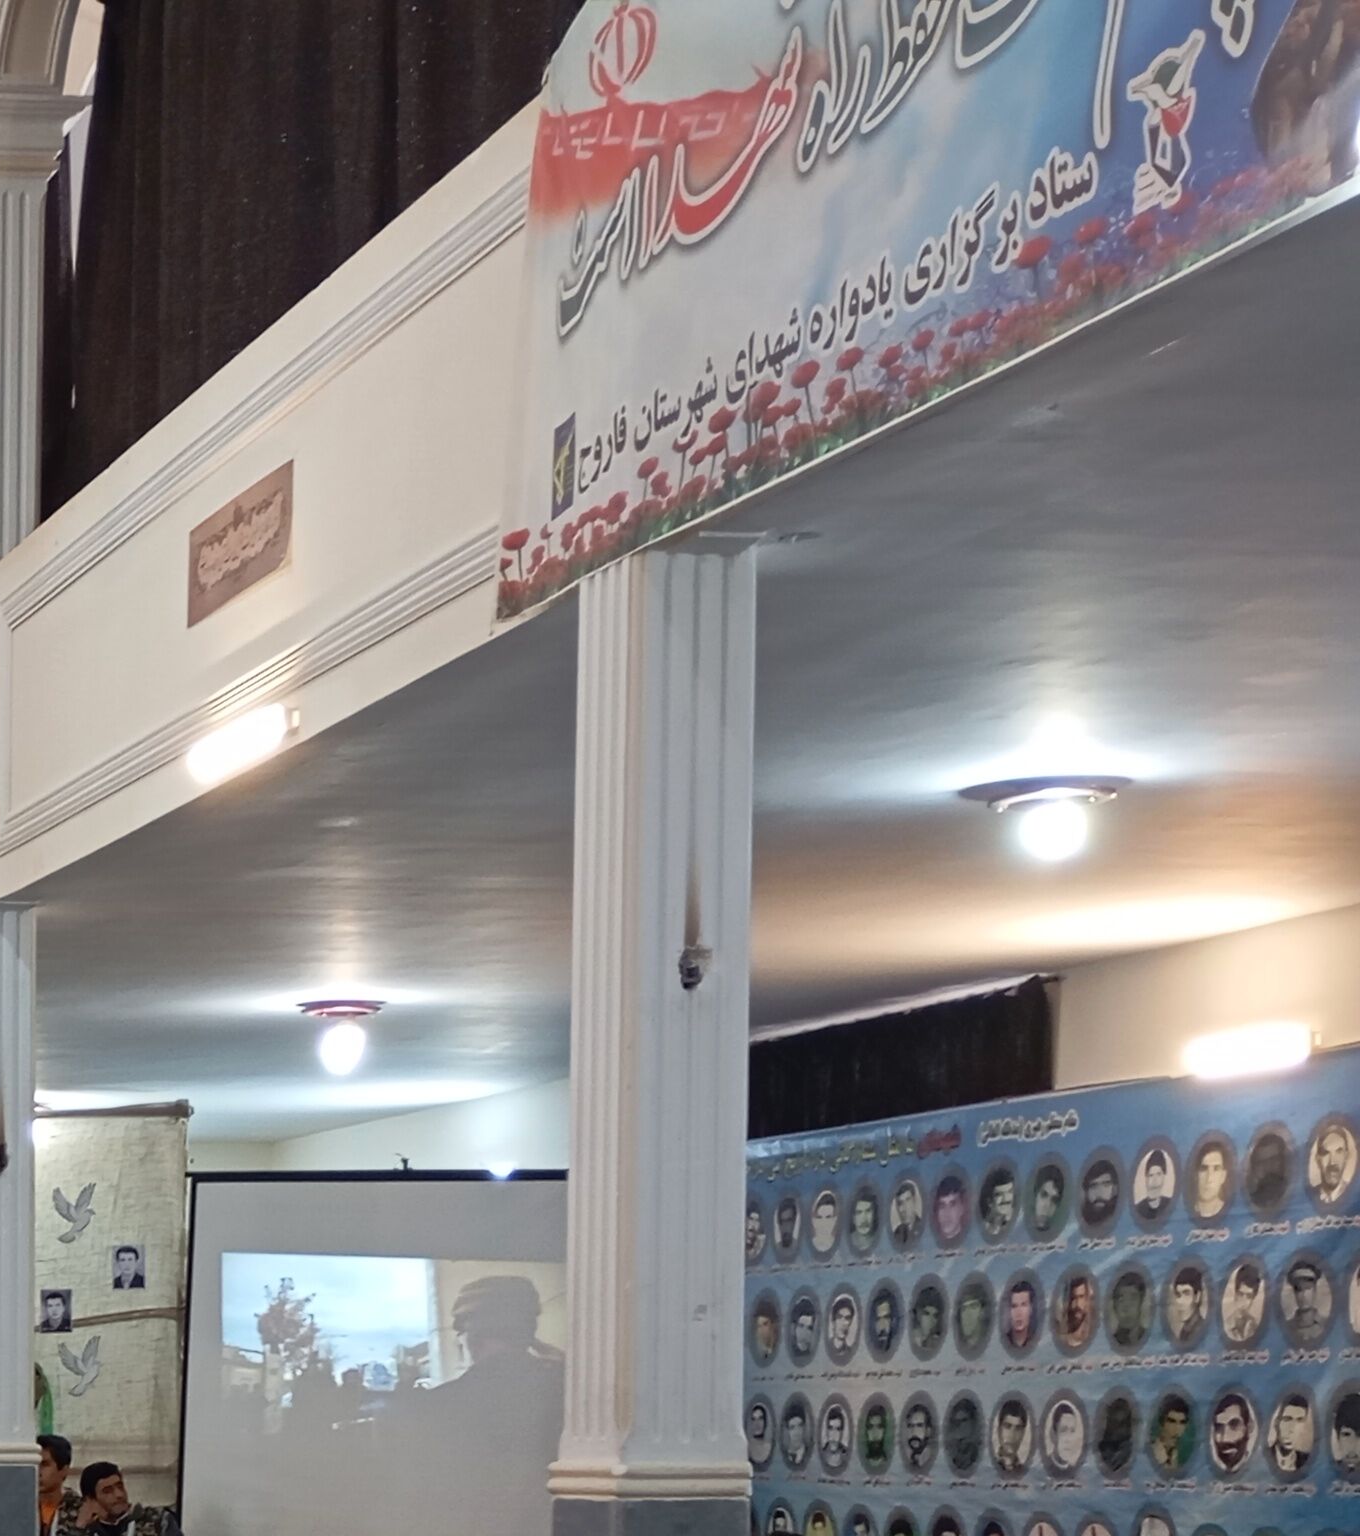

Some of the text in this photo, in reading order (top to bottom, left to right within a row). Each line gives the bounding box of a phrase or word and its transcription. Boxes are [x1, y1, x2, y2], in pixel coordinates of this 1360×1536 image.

[1028, 147, 1098, 228] ستاد
[809, 253, 894, 352] یادواره
[725, 307, 801, 404] شهدای
[579, 404, 628, 494] فاروج
[634, 356, 718, 452] شهرستان
